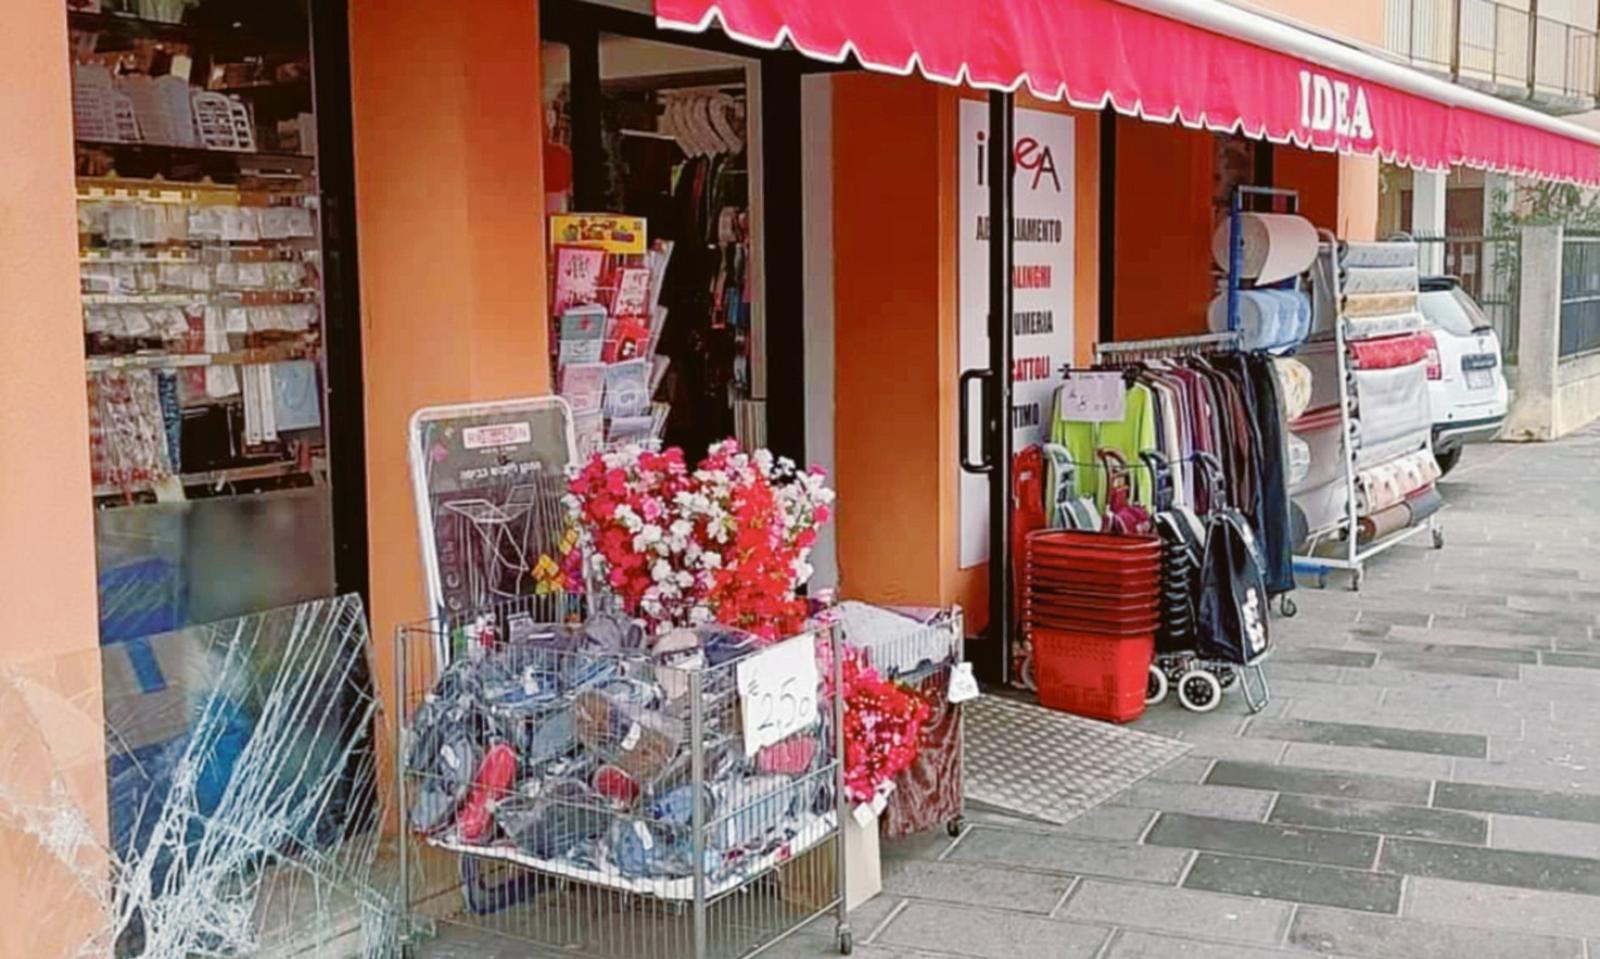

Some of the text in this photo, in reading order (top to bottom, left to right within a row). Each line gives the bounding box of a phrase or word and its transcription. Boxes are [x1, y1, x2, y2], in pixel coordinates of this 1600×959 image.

[1299, 69, 1374, 139] IDEA
[976, 130, 1062, 192] ieA
[1013, 309, 1054, 336] UMERIA
